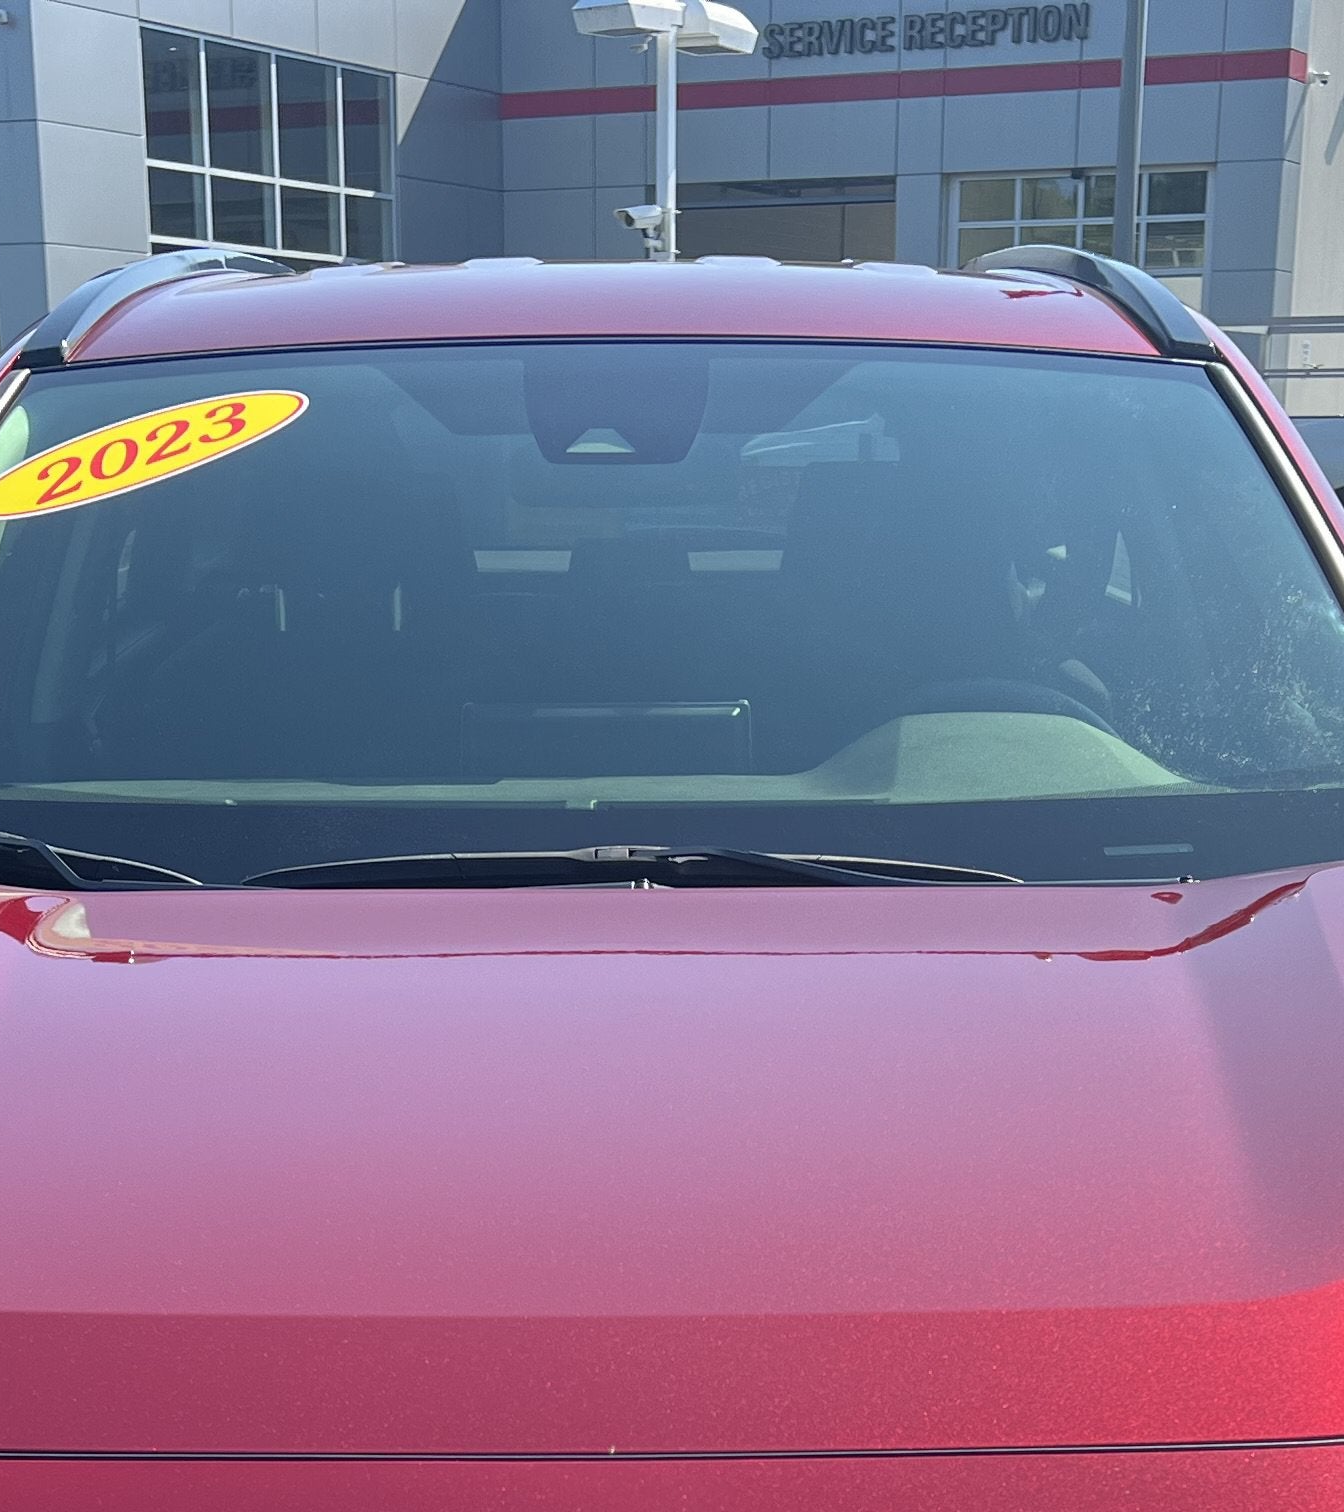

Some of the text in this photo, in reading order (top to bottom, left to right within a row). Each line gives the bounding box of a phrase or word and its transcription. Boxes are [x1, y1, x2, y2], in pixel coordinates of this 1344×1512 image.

[762, 3, 1090, 60] SERVICE RECEPTION
[35, 402, 247, 505] 2023
